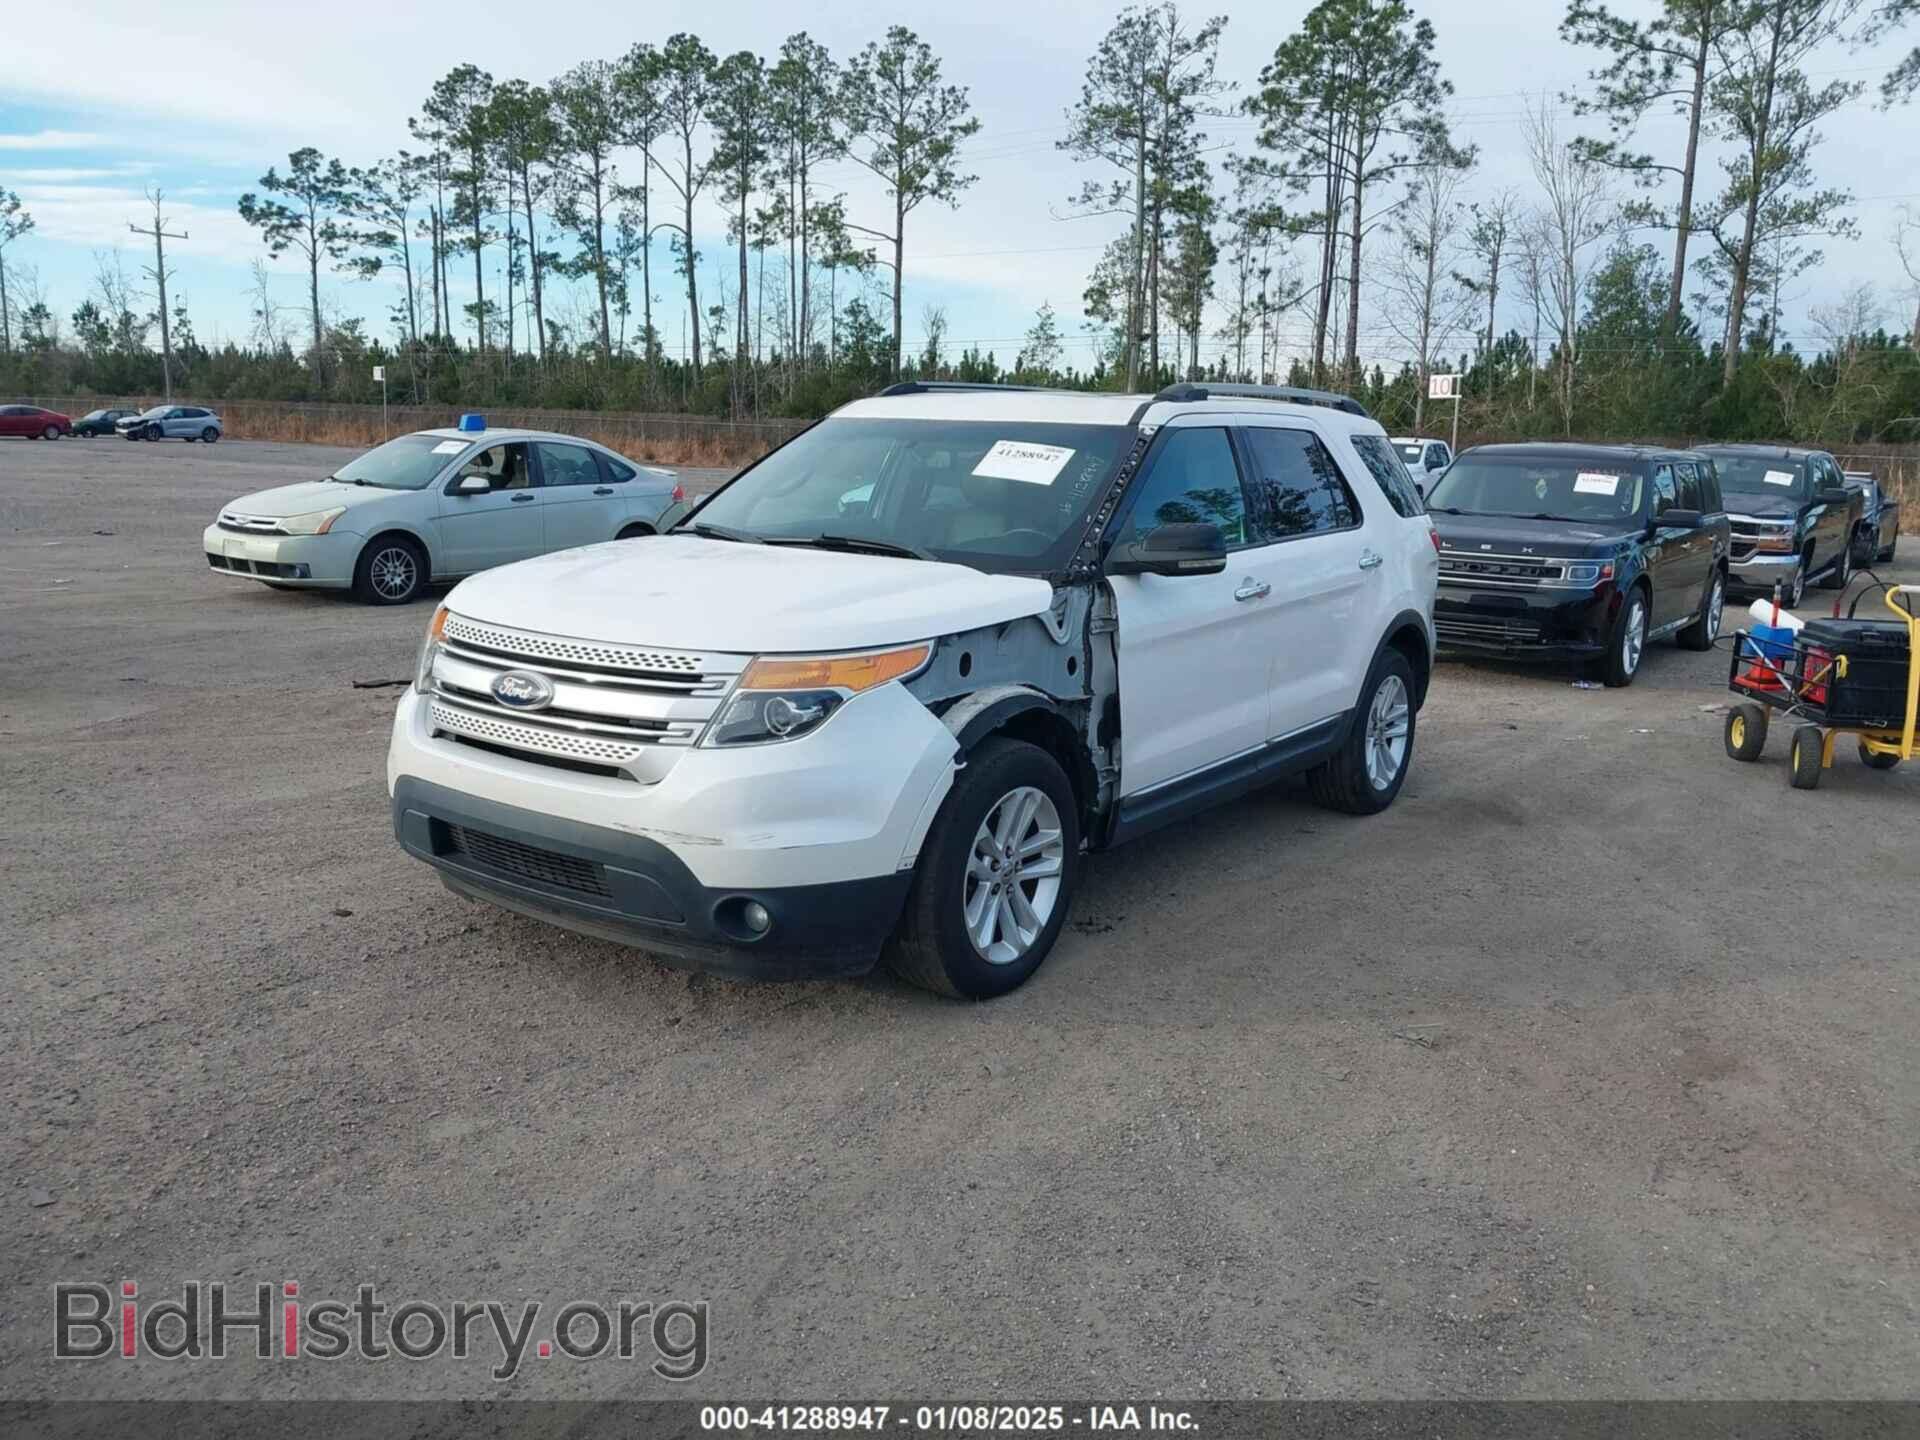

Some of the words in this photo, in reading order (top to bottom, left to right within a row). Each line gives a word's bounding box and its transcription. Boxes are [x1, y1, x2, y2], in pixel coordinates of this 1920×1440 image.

[1431, 377, 1450, 395] 10
[997, 448, 1060, 463] 41288947
[499, 677, 533, 699] Ford
